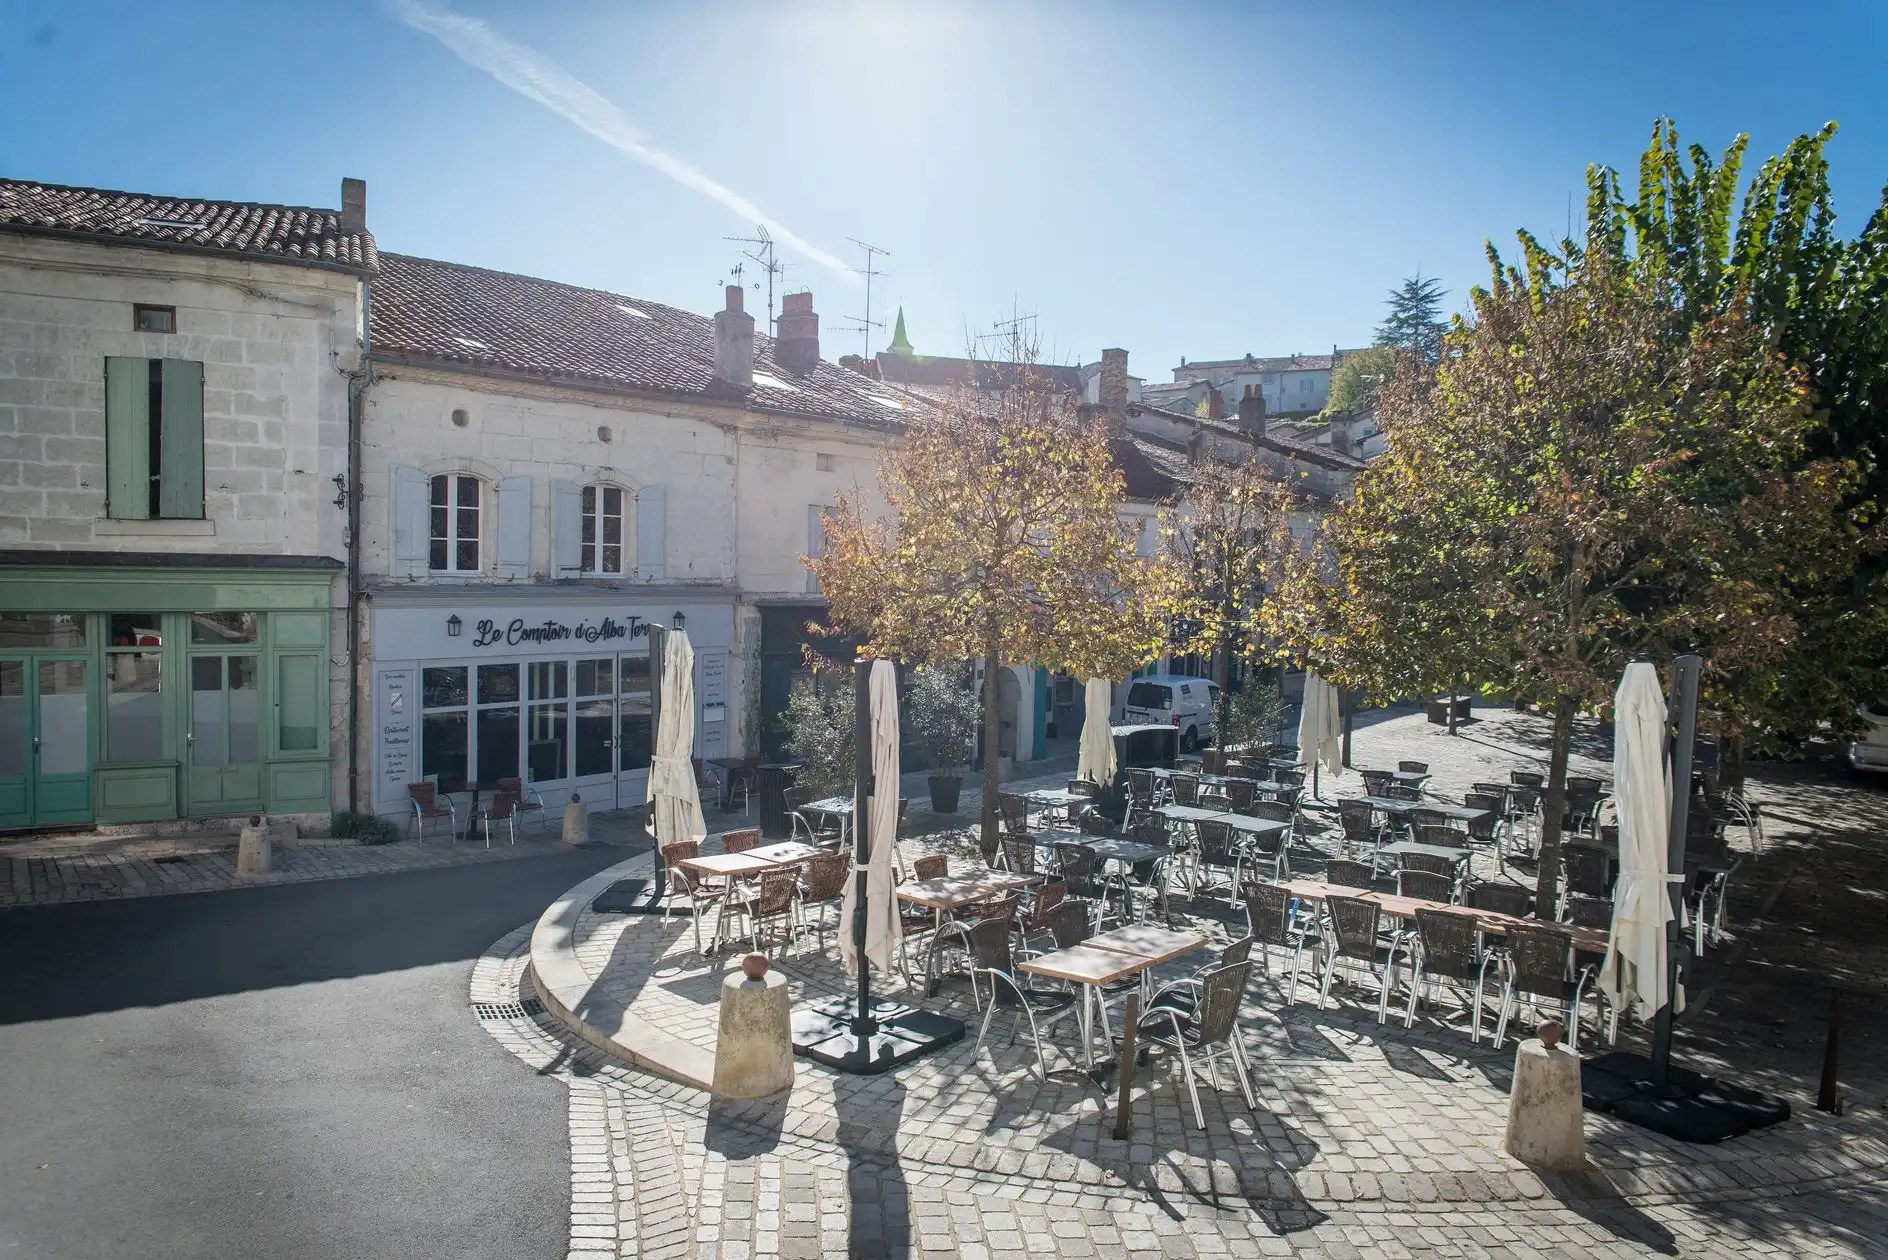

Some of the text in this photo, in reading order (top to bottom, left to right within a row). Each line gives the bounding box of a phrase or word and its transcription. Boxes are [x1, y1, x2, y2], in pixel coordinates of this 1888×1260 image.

[473, 615, 651, 647] Le Comptoir d'Alba Ter
